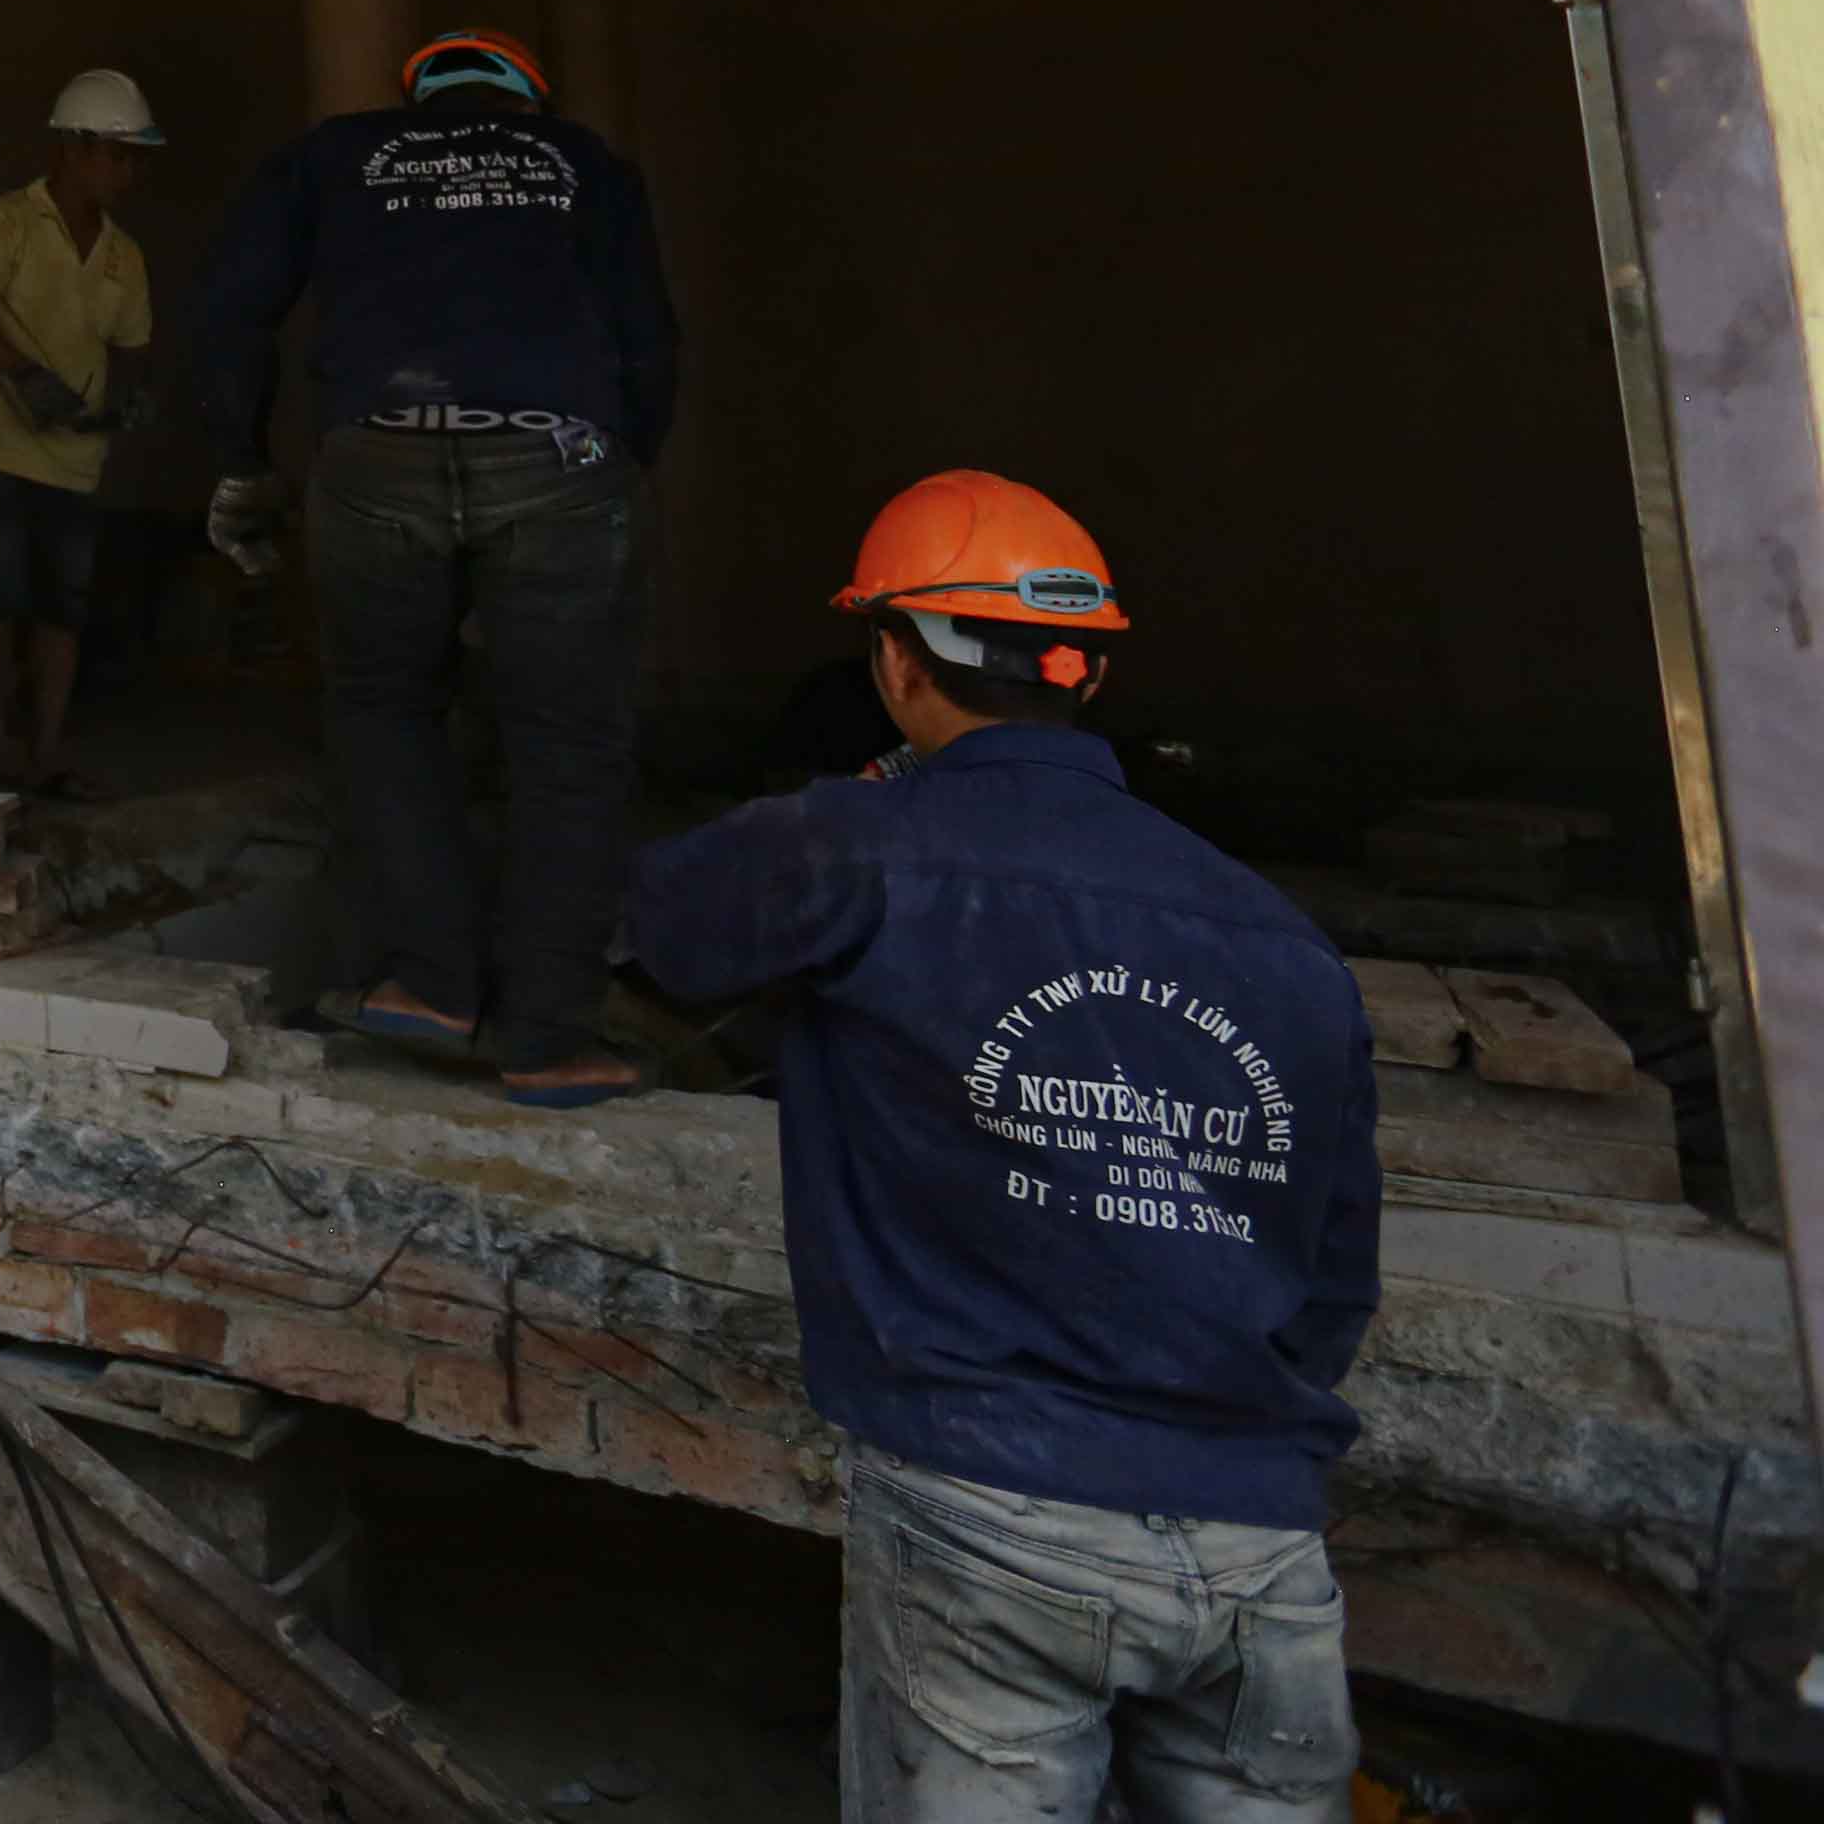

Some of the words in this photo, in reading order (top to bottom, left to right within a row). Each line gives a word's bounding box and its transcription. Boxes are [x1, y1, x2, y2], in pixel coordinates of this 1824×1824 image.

[964, 1041, 1011, 1108] CÔNG
[996, 1005, 1034, 1037] TY
[1088, 964, 1130, 996] XỬ
[1141, 979, 1179, 1008] LÝ
[1184, 999, 1238, 1044] LÚN
[1233, 1042, 1293, 1152] NGHIÊNG
[1151, 1087, 1195, 1139] ĂN
[1204, 1105, 1250, 1147] CƯ
[974, 1113, 1047, 1148] CHỐNG
[1056, 1124, 1097, 1152] LÚN
[1188, 1148, 1241, 1176] NÂNG
[1248, 1160, 1289, 1183] NHÀ
[1007, 1169, 1052, 1207] ĐT
[1108, 1164, 1129, 1186] DI
[1138, 1165, 1174, 1191] DỜI
[1178, 1171, 1207, 1194] NH
